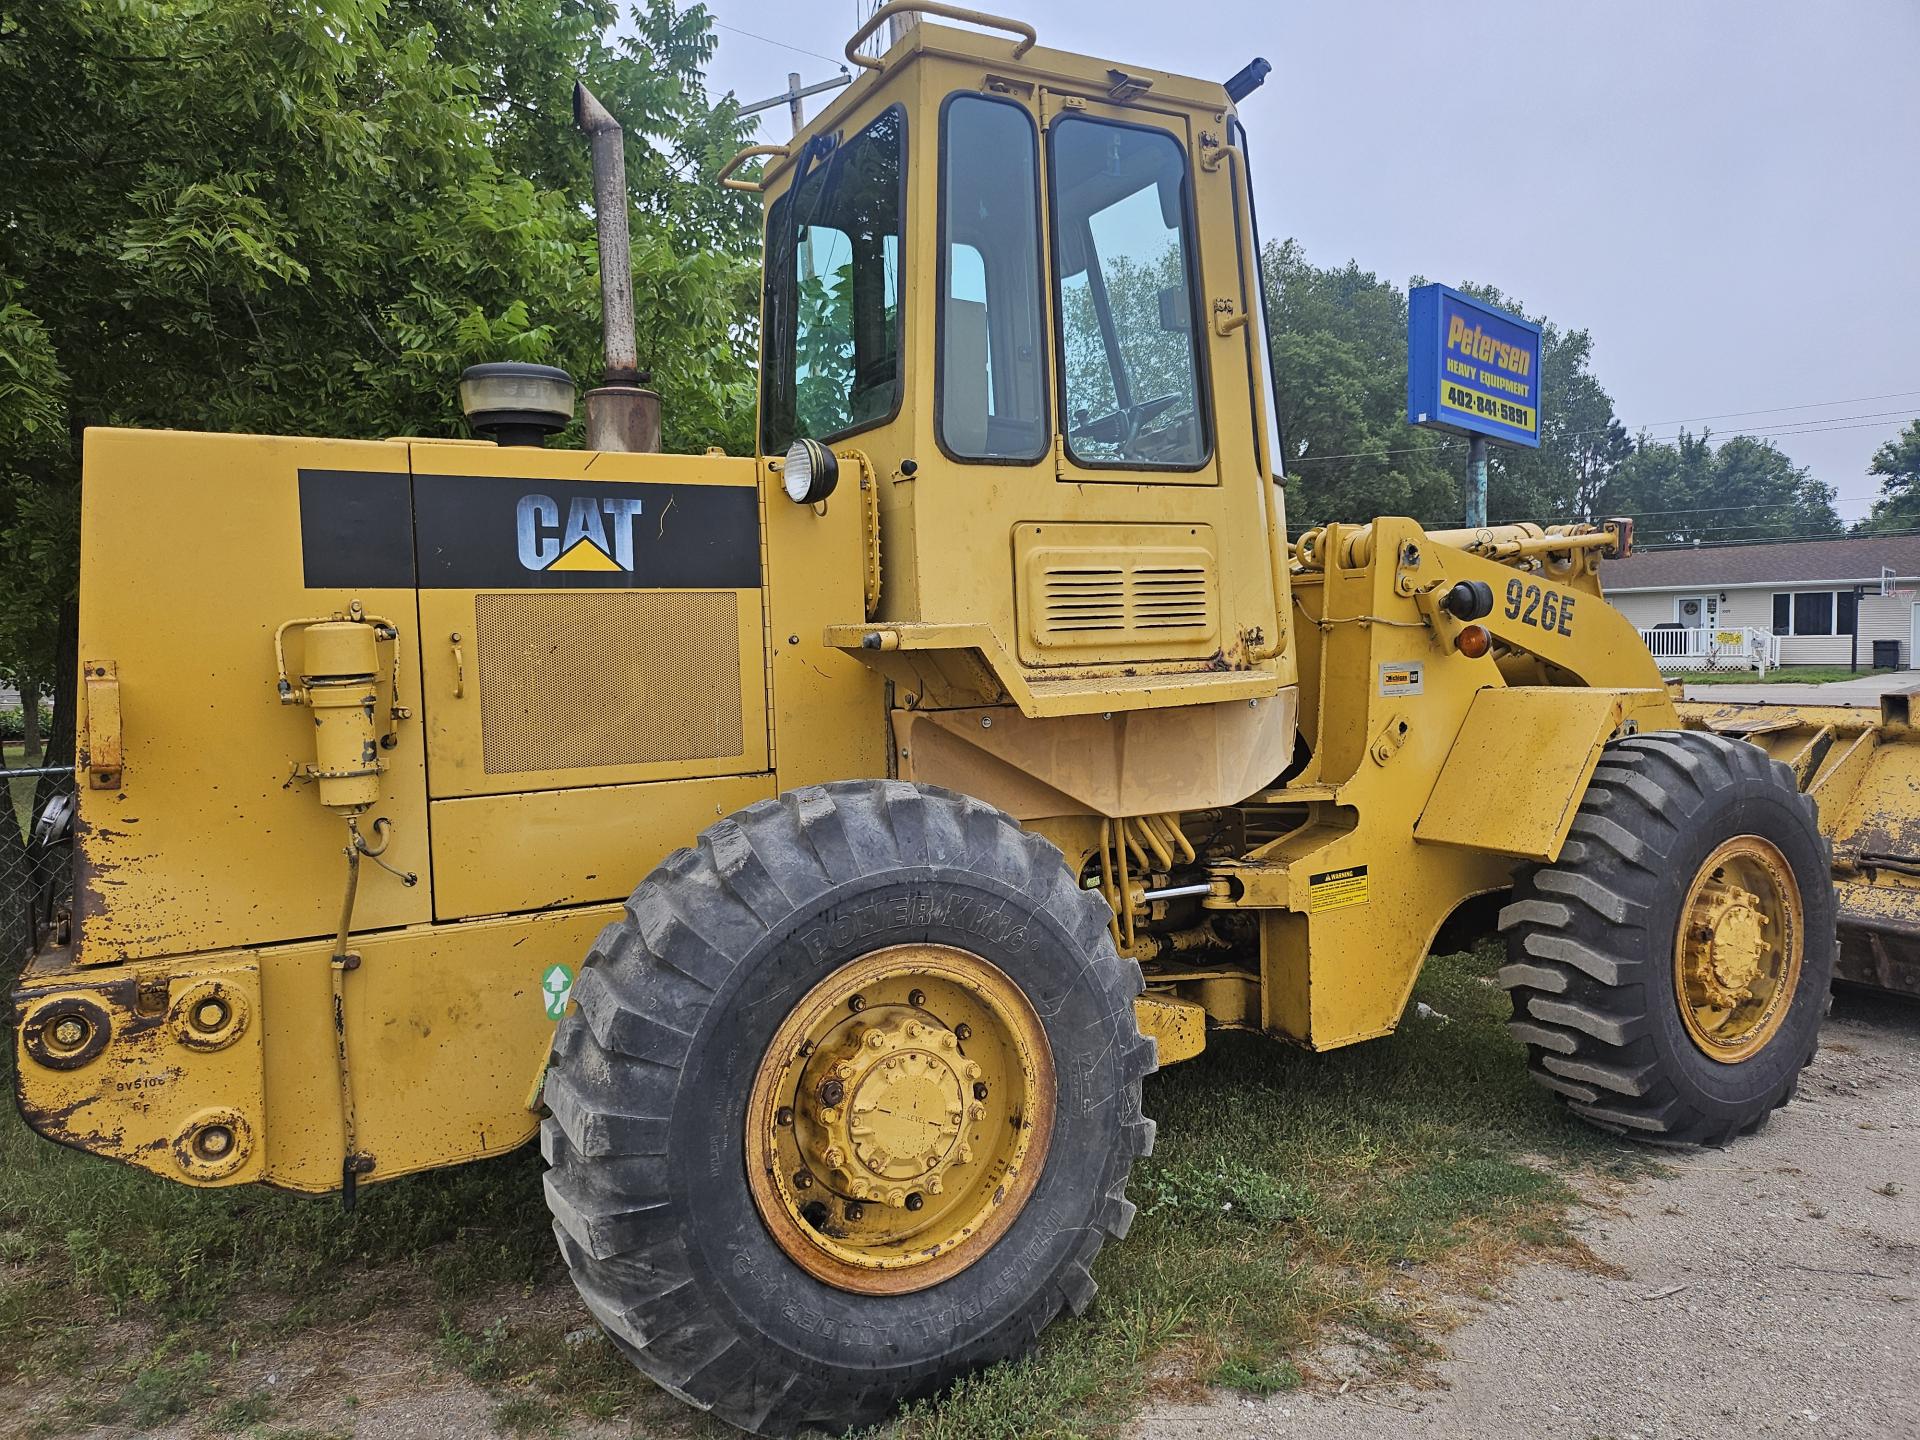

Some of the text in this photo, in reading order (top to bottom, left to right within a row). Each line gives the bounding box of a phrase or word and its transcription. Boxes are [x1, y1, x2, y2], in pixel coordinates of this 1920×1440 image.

[1448, 314, 1530, 376] Petersen
[1447, 359, 1529, 397] HEAVY EQUIPMENT
[516, 494, 642, 572] CAT
[1504, 578, 1576, 637] 926E
[1330, 870, 1354, 880] WARNING
